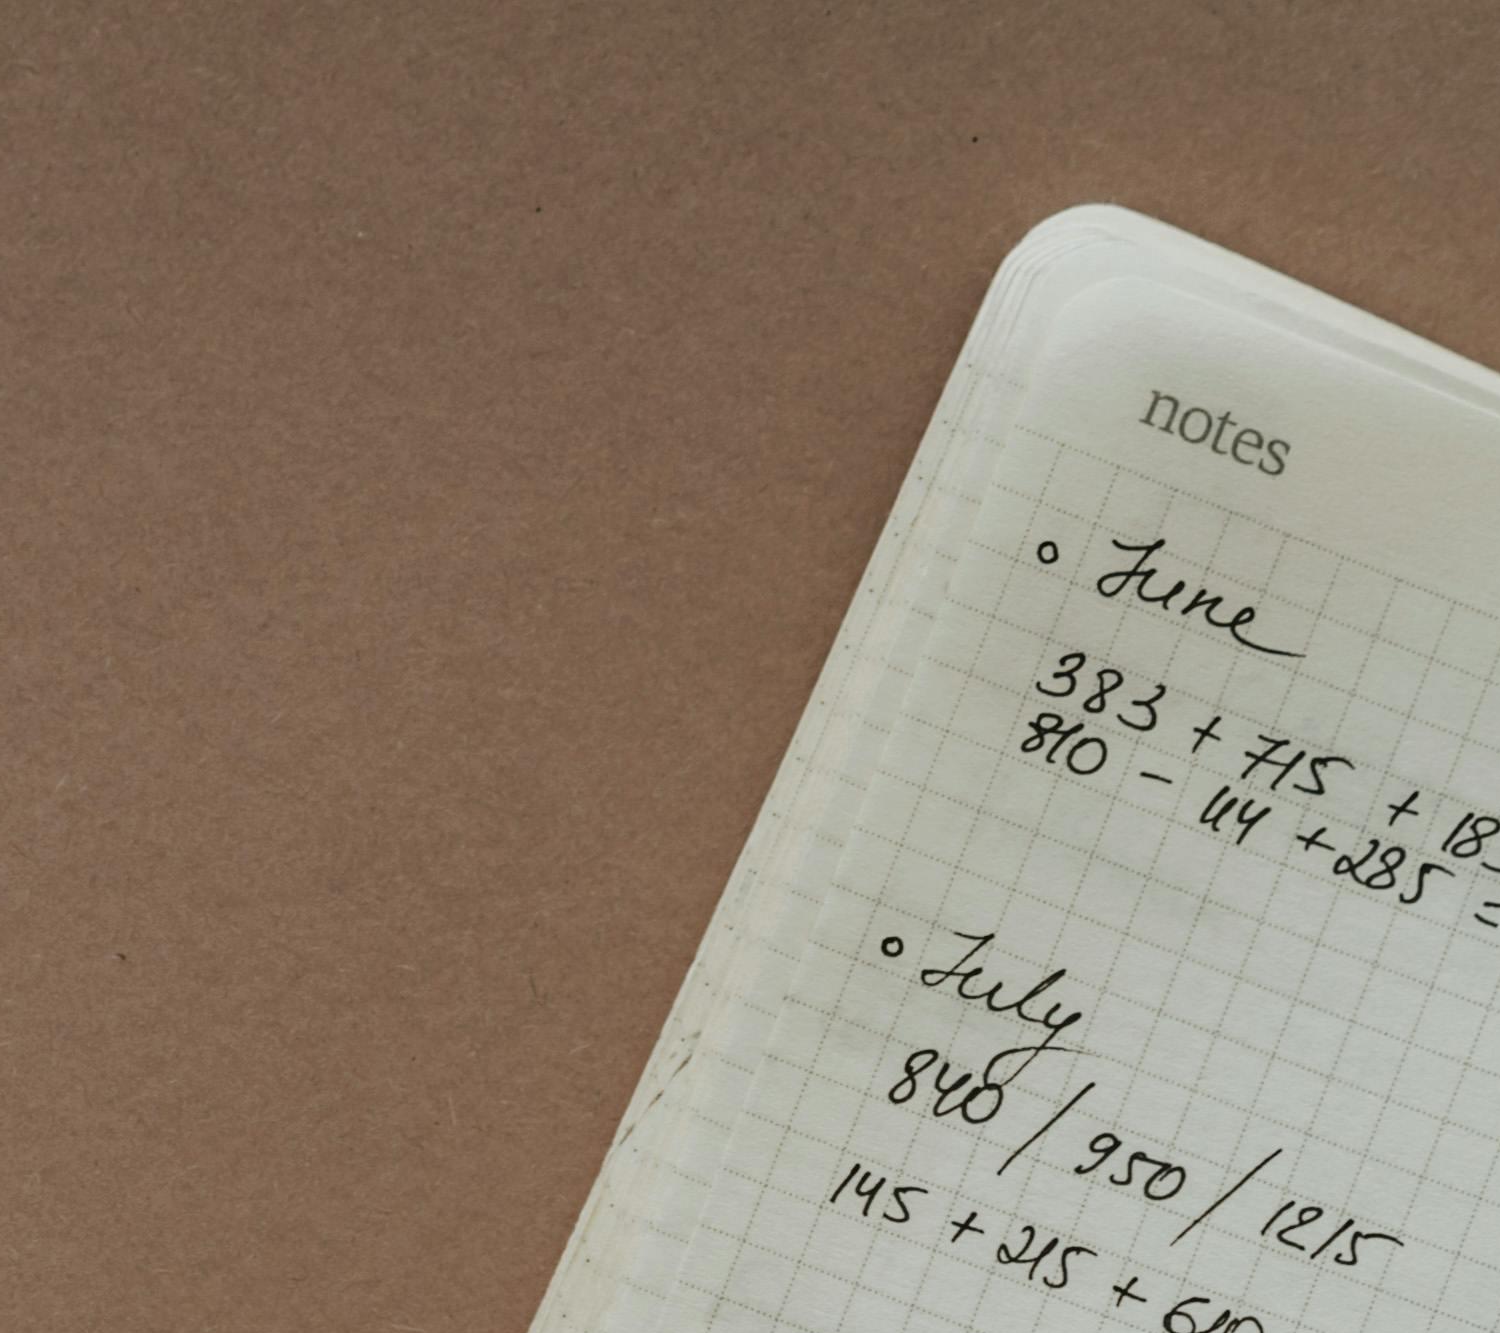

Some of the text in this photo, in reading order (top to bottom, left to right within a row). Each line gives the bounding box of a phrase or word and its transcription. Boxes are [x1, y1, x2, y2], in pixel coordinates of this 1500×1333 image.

[1138, 388, 1291, 476] notes
[1097, 539, 1306, 657] June
[1036, 652, 1166, 731] 383
[1241, 734, 1355, 796] 715
[1333, 838, 1456, 903] 285
[921, 932, 1100, 1085] July
[888, 1048, 1404, 1265] 840 950 1215
[829, 1163, 929, 1223] 145
[997, 1226, 1097, 1288] 215
